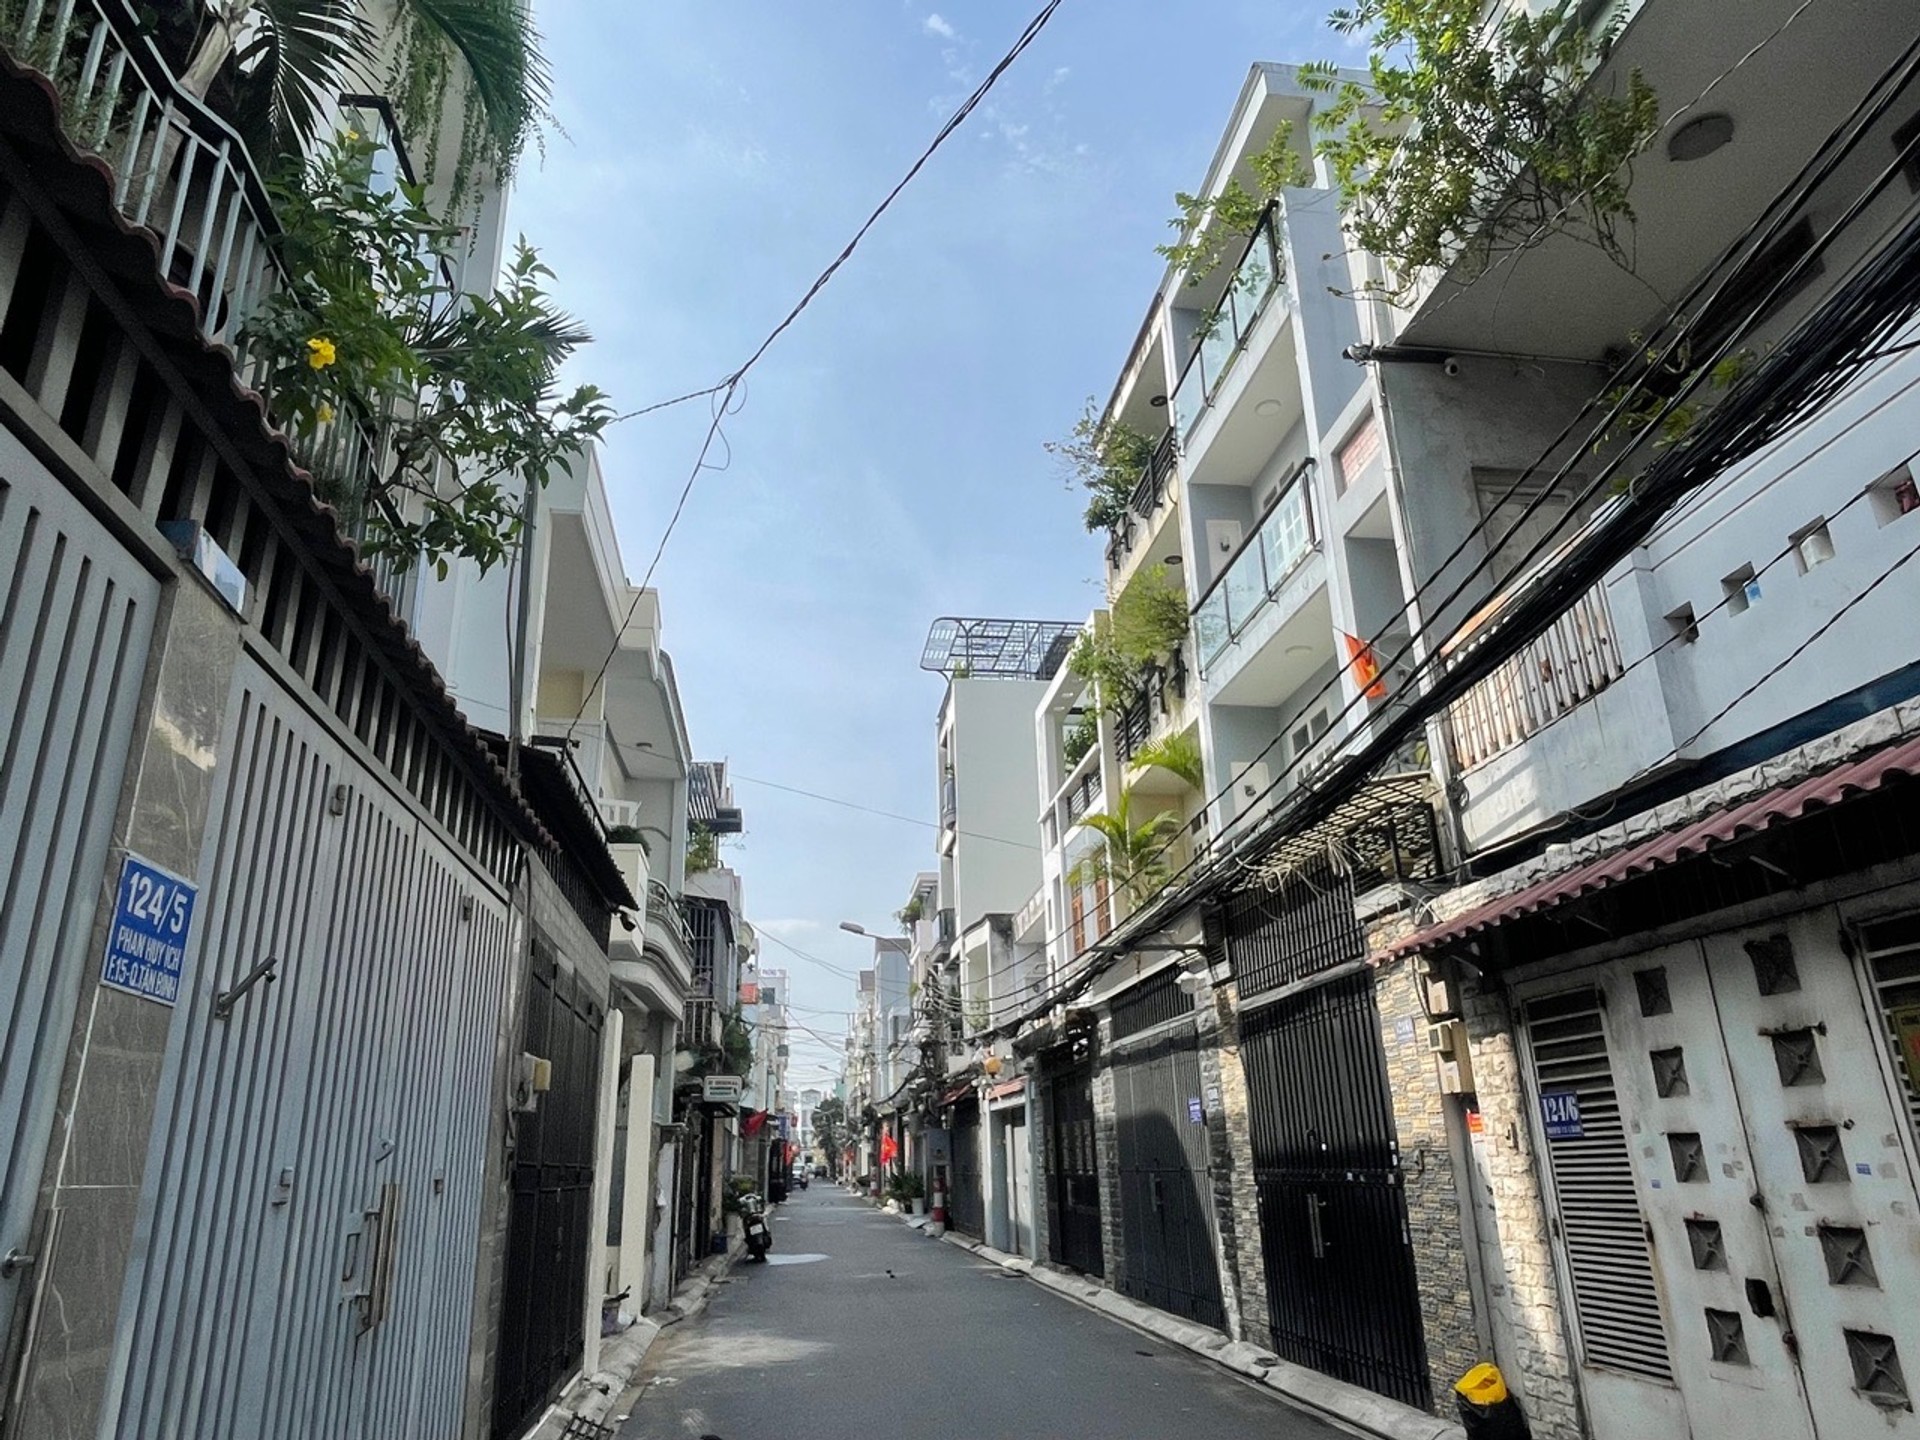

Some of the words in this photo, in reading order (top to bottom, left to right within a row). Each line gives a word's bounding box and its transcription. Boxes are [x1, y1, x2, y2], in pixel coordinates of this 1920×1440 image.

[127, 871, 188, 934] 124/5
[116, 925, 147, 958] PHAN
[144, 937, 167, 966] HUY
[1542, 1096, 1578, 1122] 124/6
